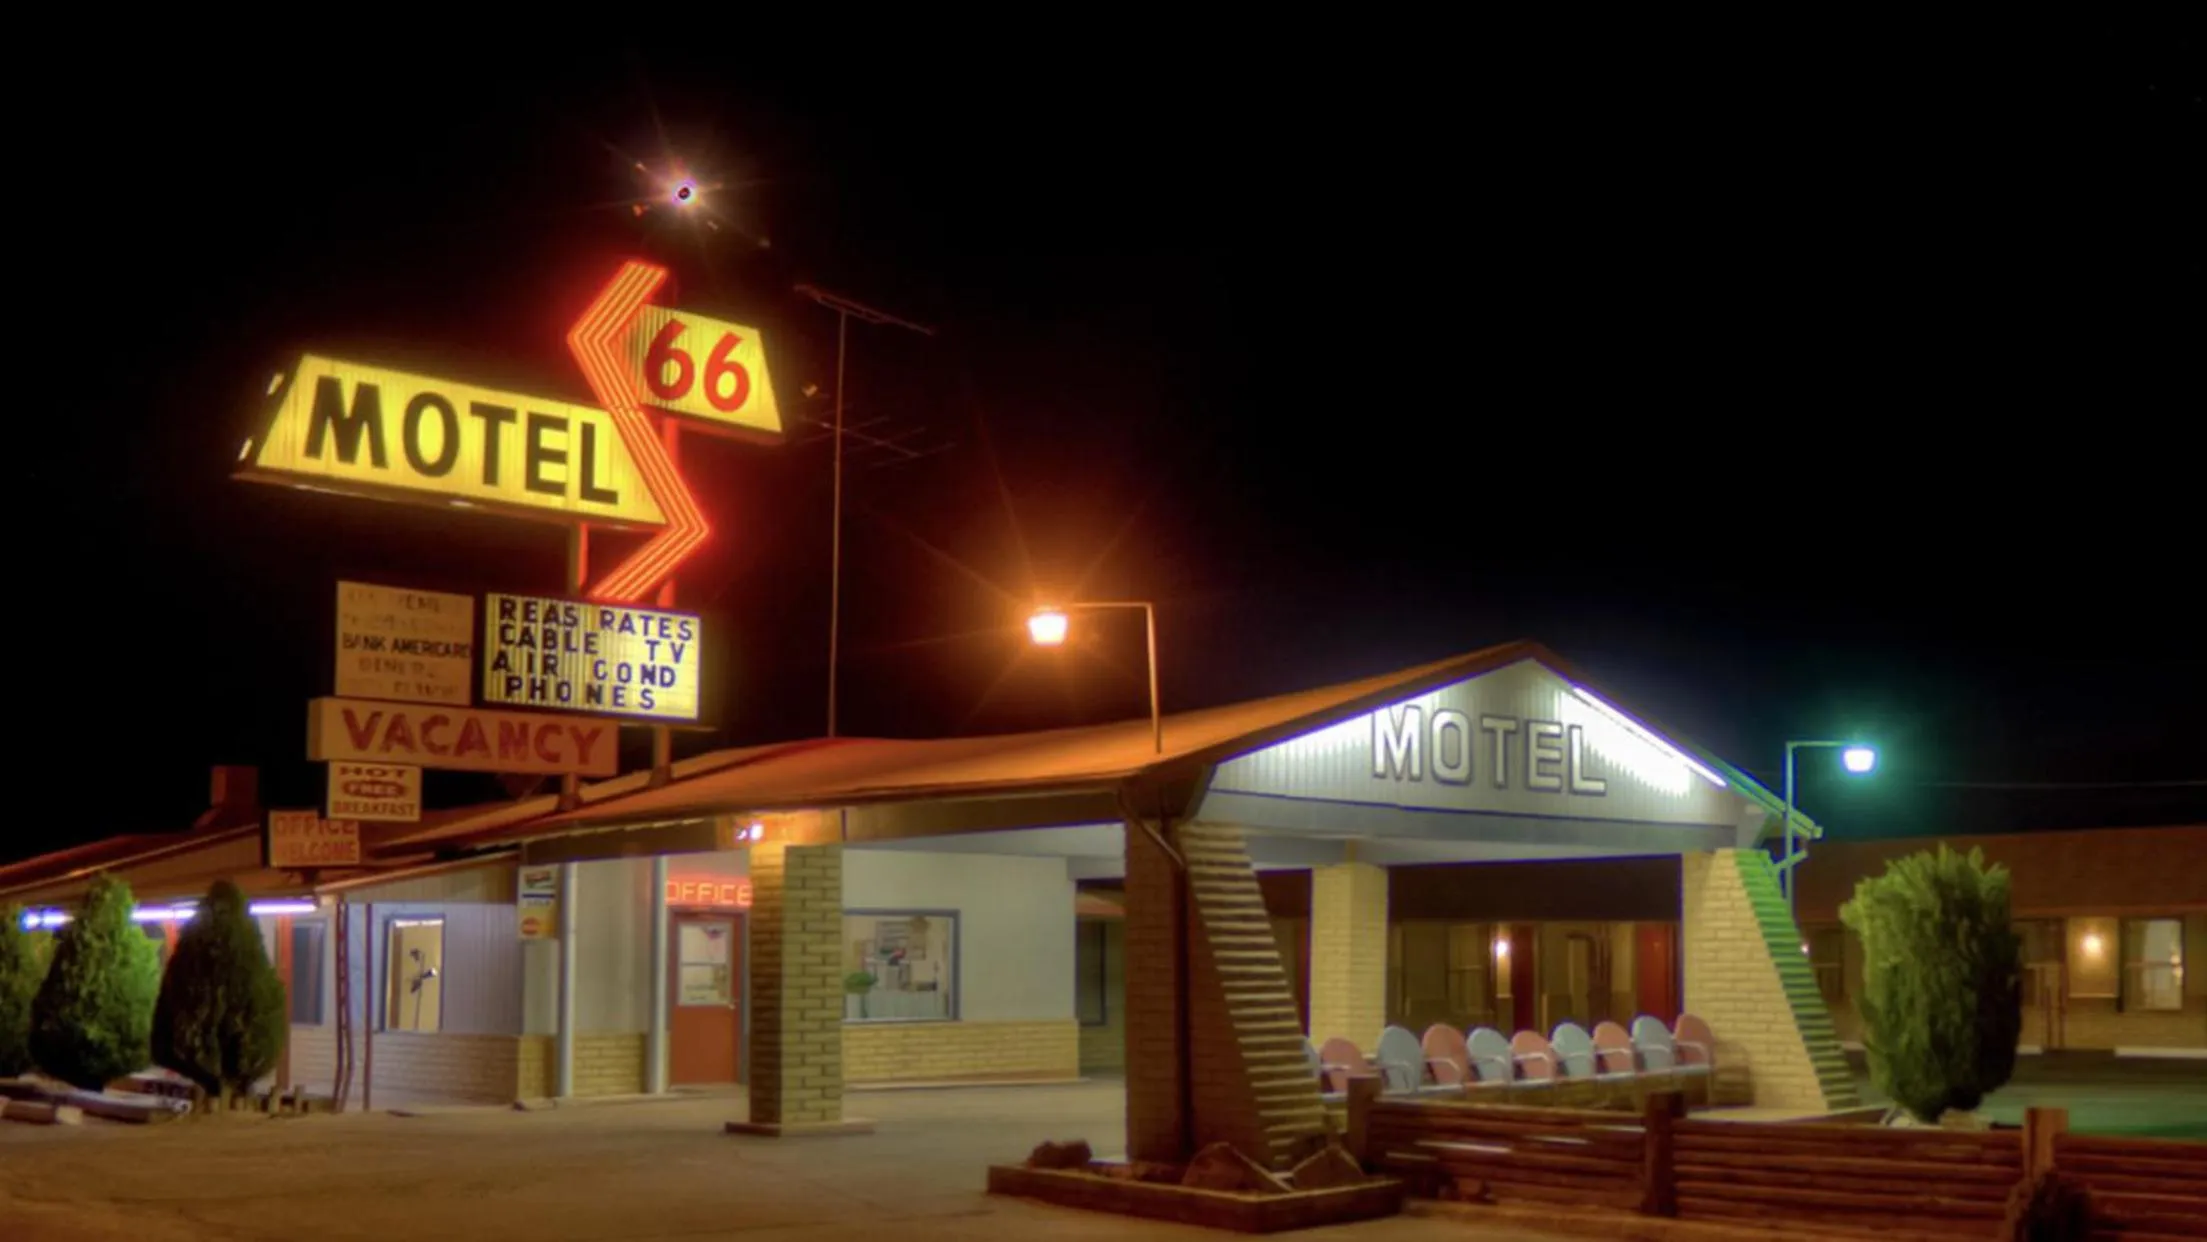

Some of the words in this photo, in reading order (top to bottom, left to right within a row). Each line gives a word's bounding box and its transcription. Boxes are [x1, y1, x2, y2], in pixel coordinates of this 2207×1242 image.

[643, 318, 751, 413] 66
[303, 374, 619, 506] MOTEL
[500, 599, 579, 628] REAS
[599, 610, 693, 641] RATES
[342, 631, 387, 653] BANK
[500, 624, 599, 655] CABLE
[645, 639, 686, 664] TV
[490, 650, 558, 676] AIR
[593, 659, 677, 688] COND
[504, 676, 656, 710] PHONES
[341, 708, 604, 766] VACANCY
[1371, 701, 1607, 797] MOTEL
[339, 766, 407, 778] HOT
[348, 781, 398, 797] FREE
[274, 814, 358, 837] OFFICE
[333, 801, 417, 817] BREAKFAST
[274, 840, 359, 862] WELCOME
[665, 881, 754, 906] OFFICE
